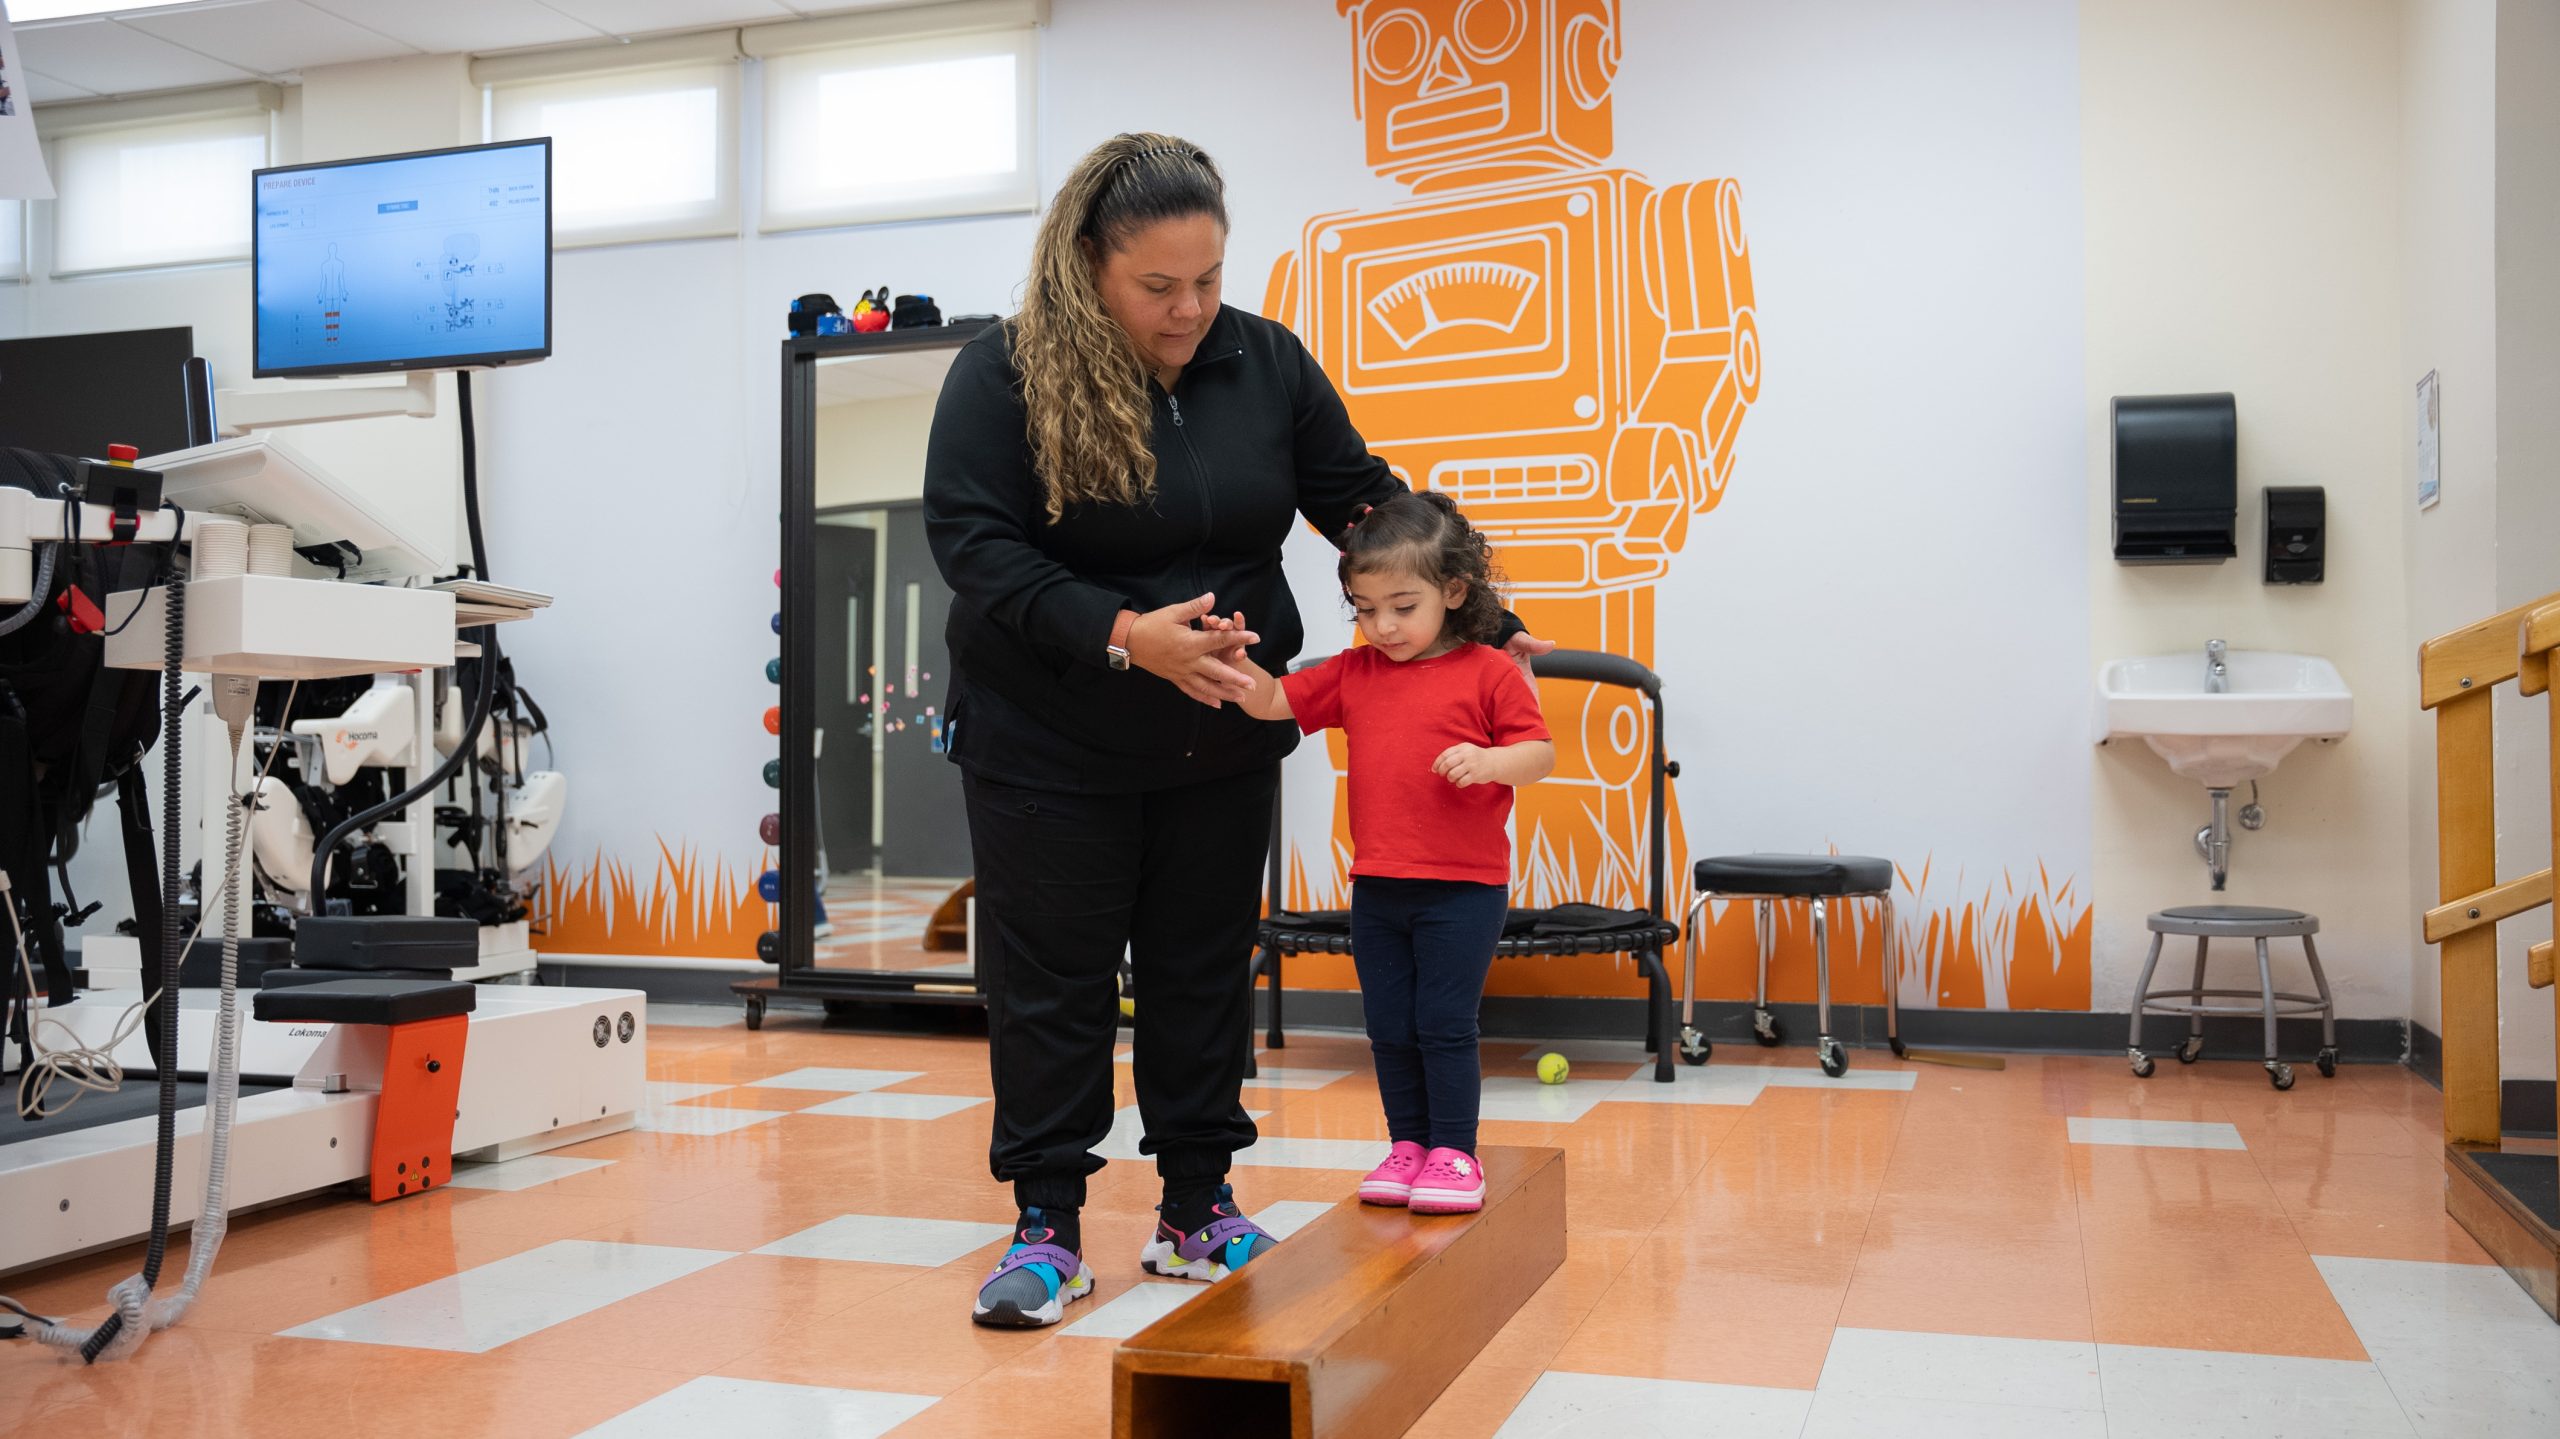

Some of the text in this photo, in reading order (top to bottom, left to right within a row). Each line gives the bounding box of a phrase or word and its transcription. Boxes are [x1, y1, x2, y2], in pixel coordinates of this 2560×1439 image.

[263, 177, 316, 190] PREPARE DEVICE
[348, 730, 378, 740] Hocoma
[289, 1028, 327, 1037] Lokoma
